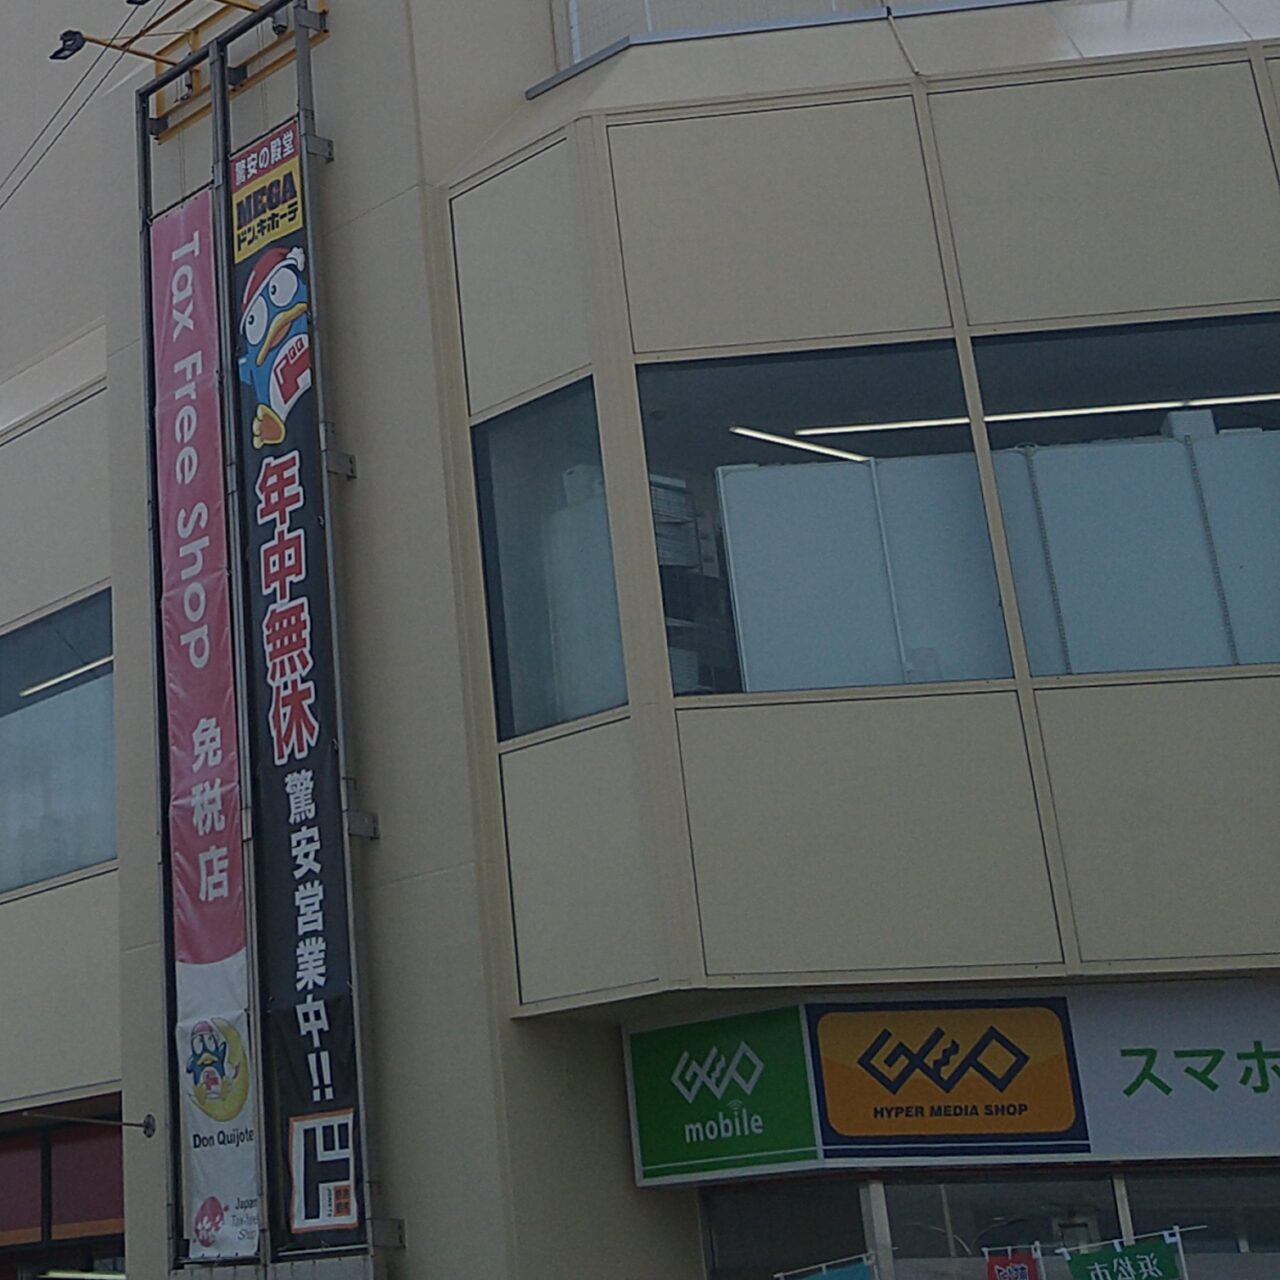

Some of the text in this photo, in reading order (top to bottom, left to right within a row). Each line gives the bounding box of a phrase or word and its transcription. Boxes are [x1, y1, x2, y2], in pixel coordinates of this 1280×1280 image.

[234, 129, 295, 186] 驚安の殿堂
[236, 171, 297, 230] MEGA
[171, 231, 210, 669] Tax Free Shop
[256, 450, 319, 765] 年中無休
[190, 717, 230, 903] 免税店
[1120, 1039, 1280, 1096] スマホ
[193, 1128, 254, 1148] Don Quijote
[684, 1108, 764, 1144] mobile
[873, 1103, 1029, 1119] HYPER MEDIA SHOP
[304, 1123, 350, 1219] ド
